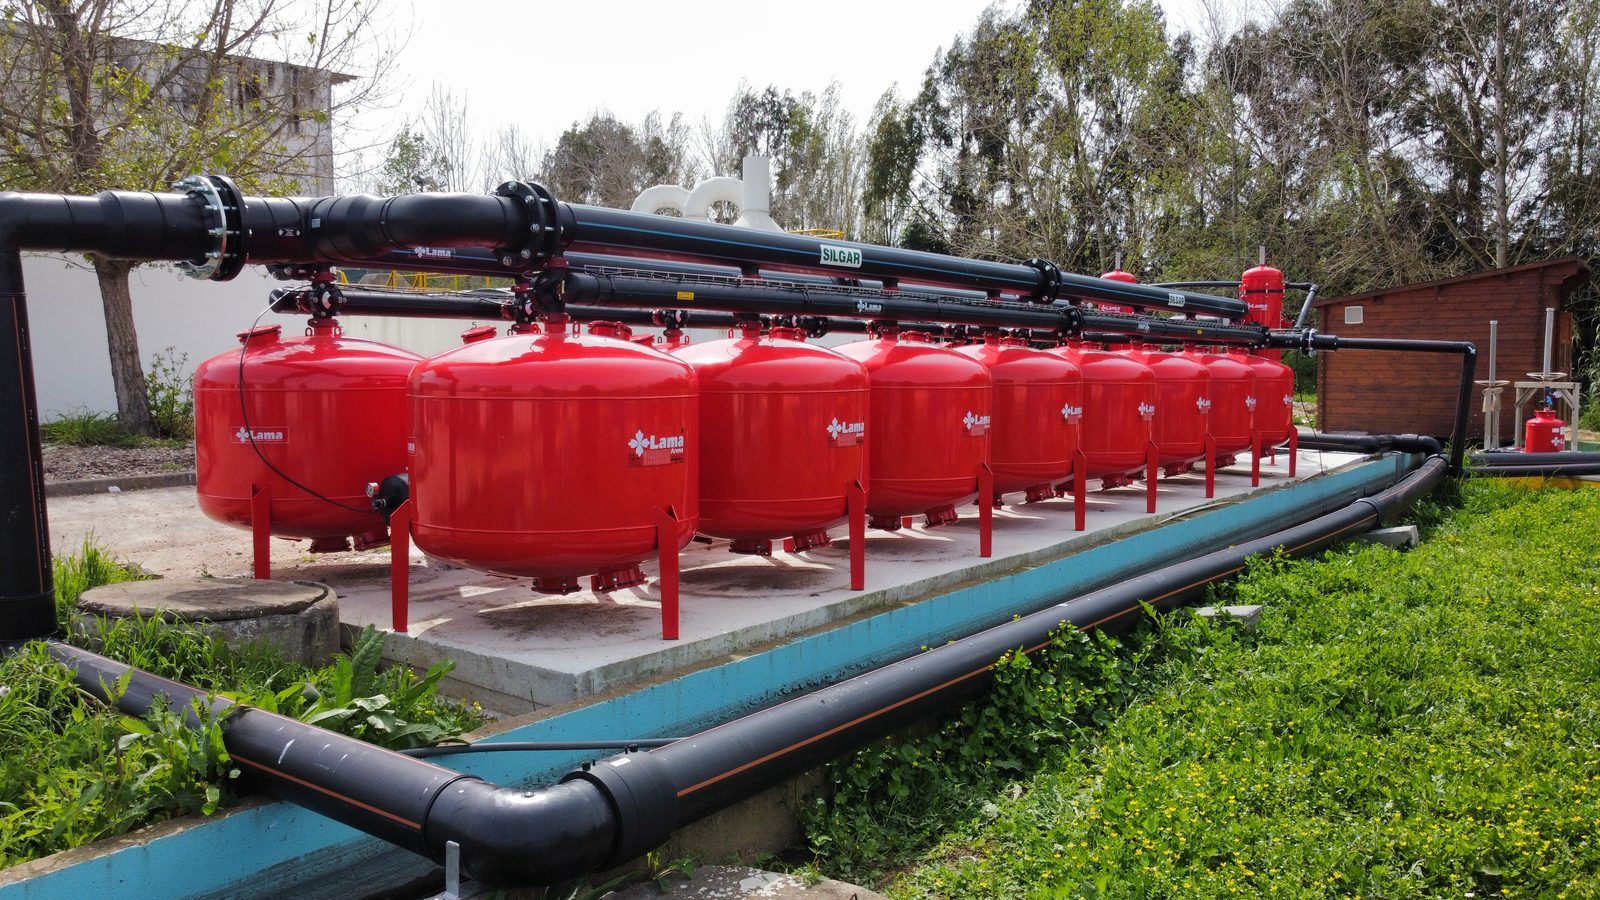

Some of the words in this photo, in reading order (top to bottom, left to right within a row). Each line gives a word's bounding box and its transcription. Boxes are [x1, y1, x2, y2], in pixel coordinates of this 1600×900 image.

[426, 247, 451, 257] Lama
[823, 248, 860, 265] SILGAR
[864, 302, 882, 312] Lama
[249, 430, 283, 440] Lama
[650, 435, 684, 450] Lama
